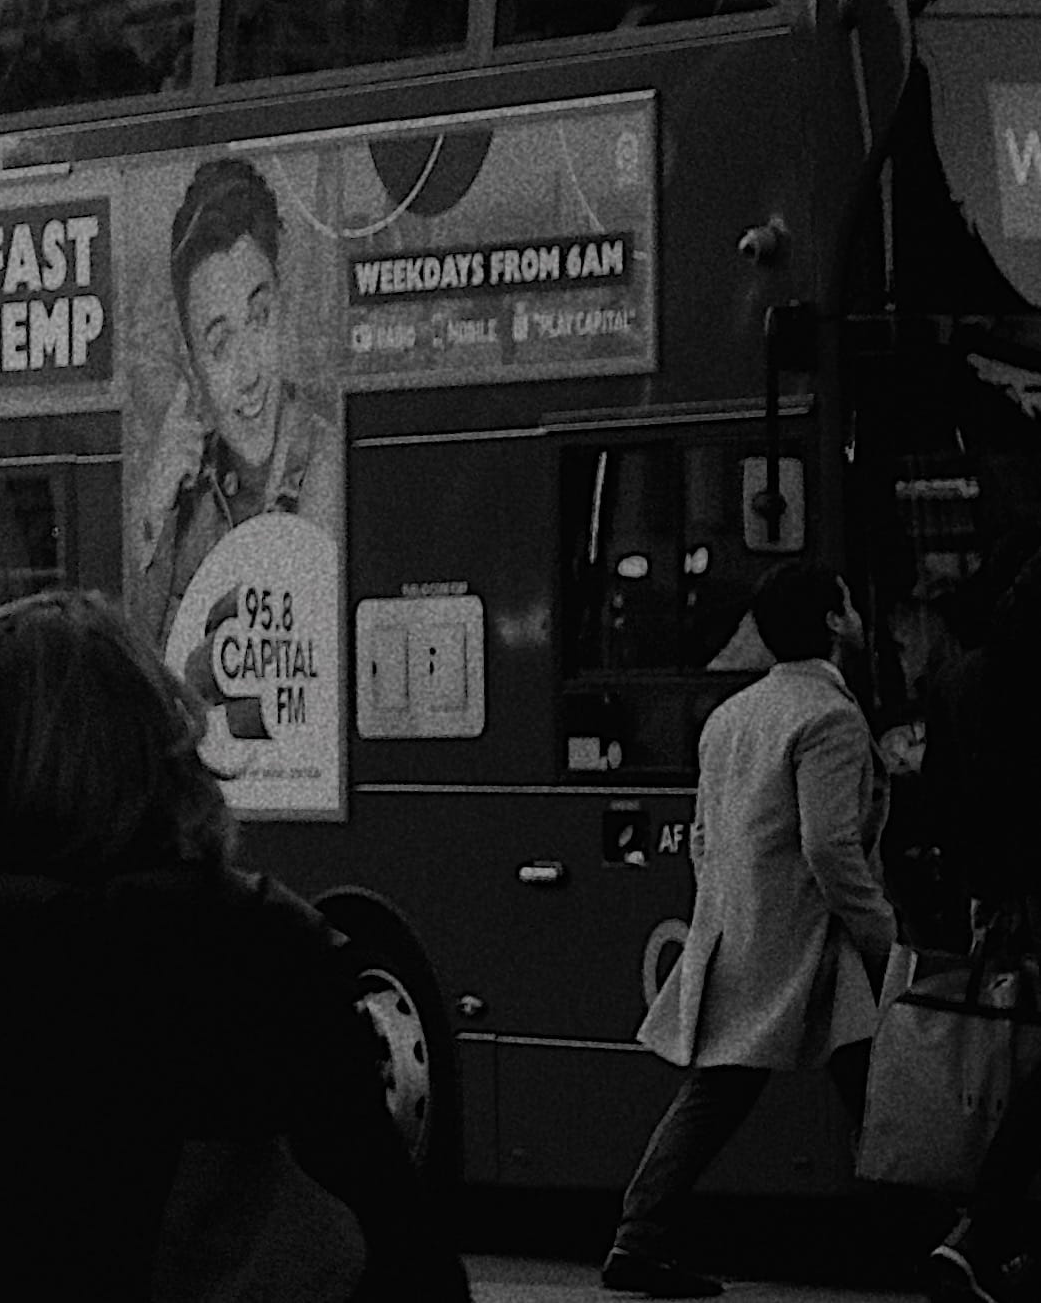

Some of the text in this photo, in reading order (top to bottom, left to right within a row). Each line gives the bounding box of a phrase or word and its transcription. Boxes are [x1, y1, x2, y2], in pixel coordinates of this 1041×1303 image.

[356, 239, 624, 295] WEEKDAYS FROM 6AM
[245, 587, 294, 631] 95.8
[220, 636, 318, 679] CAPITAL
[277, 687, 307, 724] FM
